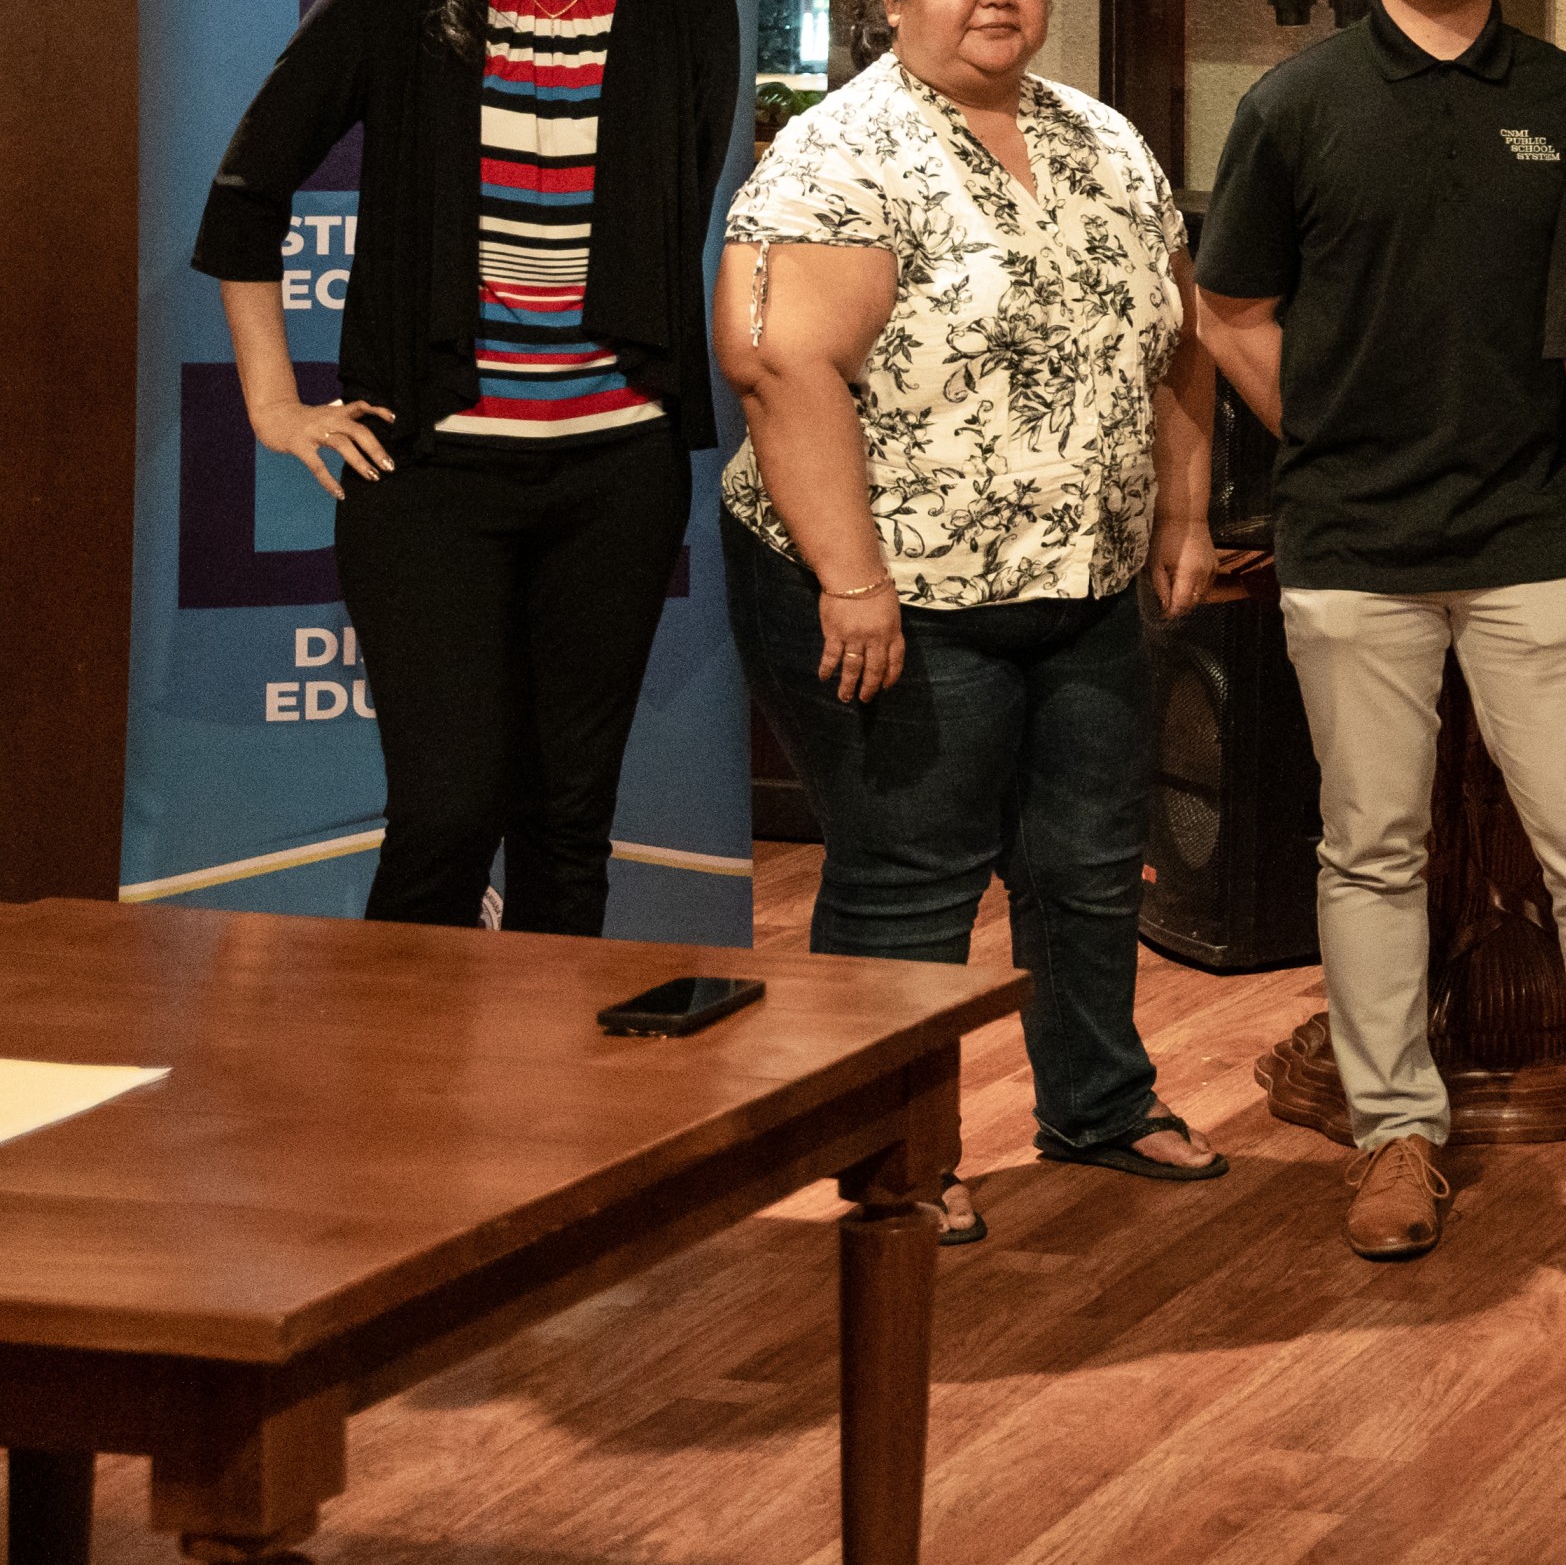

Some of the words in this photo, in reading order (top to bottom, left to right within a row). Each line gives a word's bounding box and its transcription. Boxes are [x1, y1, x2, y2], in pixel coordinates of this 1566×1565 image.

[1500, 129, 1529, 138] CNMI
[1505, 137, 1547, 145] PUBLIC
[1510, 144, 1556, 153] SCHOOL
[1516, 152, 1561, 161] SYSTEM
